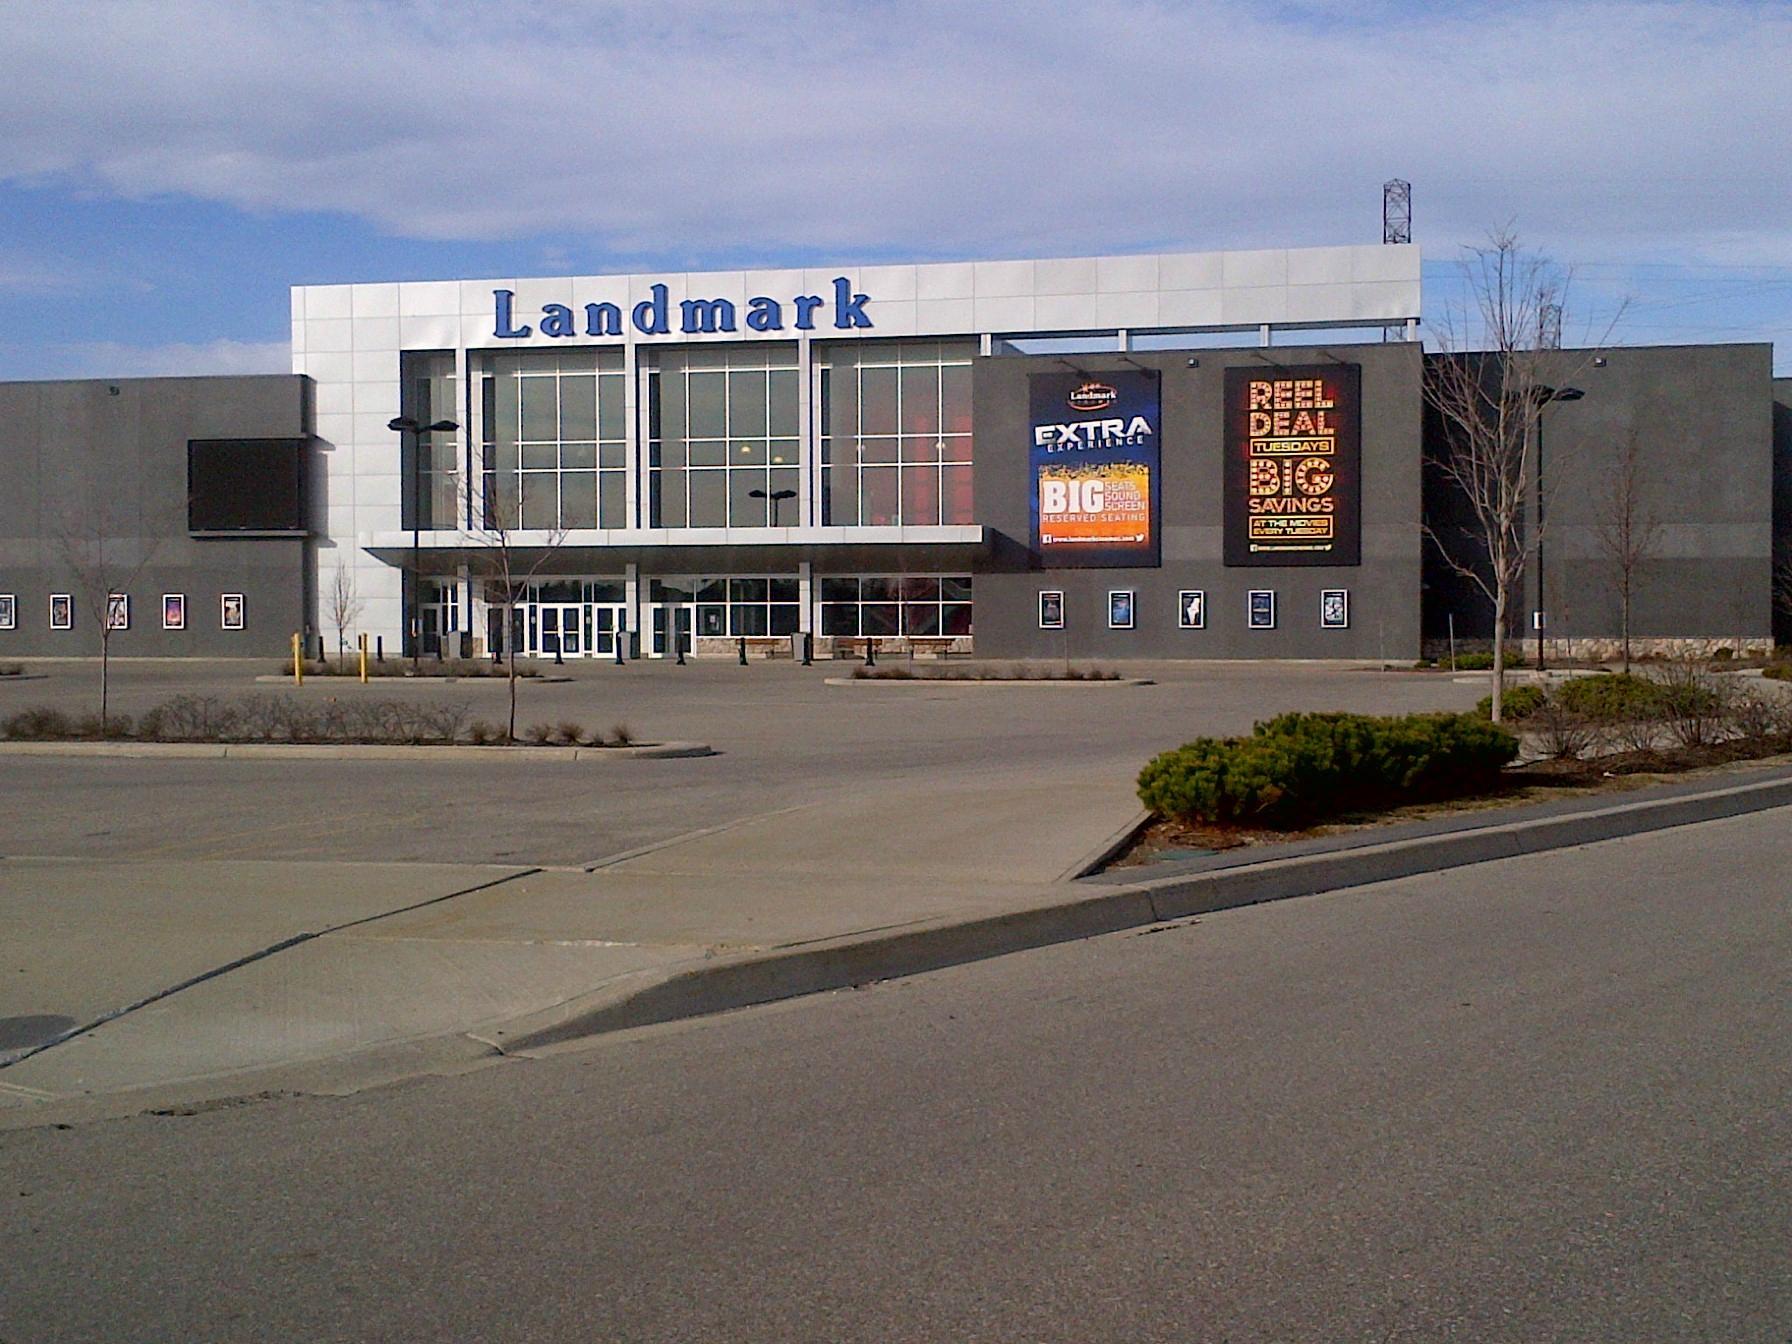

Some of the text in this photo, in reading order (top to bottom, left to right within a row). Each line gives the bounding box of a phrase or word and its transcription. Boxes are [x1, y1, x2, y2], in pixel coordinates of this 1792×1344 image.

[493, 277, 874, 339] Landmark
[1070, 391, 1117, 400] Landmark
[1249, 380, 1334, 410] REEL
[1035, 416, 1153, 446] EXTRA
[1249, 411, 1335, 436] DEAL
[1047, 435, 1144, 453] EXPERIENCE
[1253, 442, 1330, 453] TUESDAYS
[1249, 457, 1334, 496] BIG
[1104, 481, 1136, 491] SEATS
[1043, 479, 1104, 514] BIG
[1104, 491, 1140, 501] SOUND
[1104, 501, 1145, 511] SCREEN
[1248, 497, 1334, 513] SAVINGS
[1042, 513, 1145, 523] RESERVED SEATING
